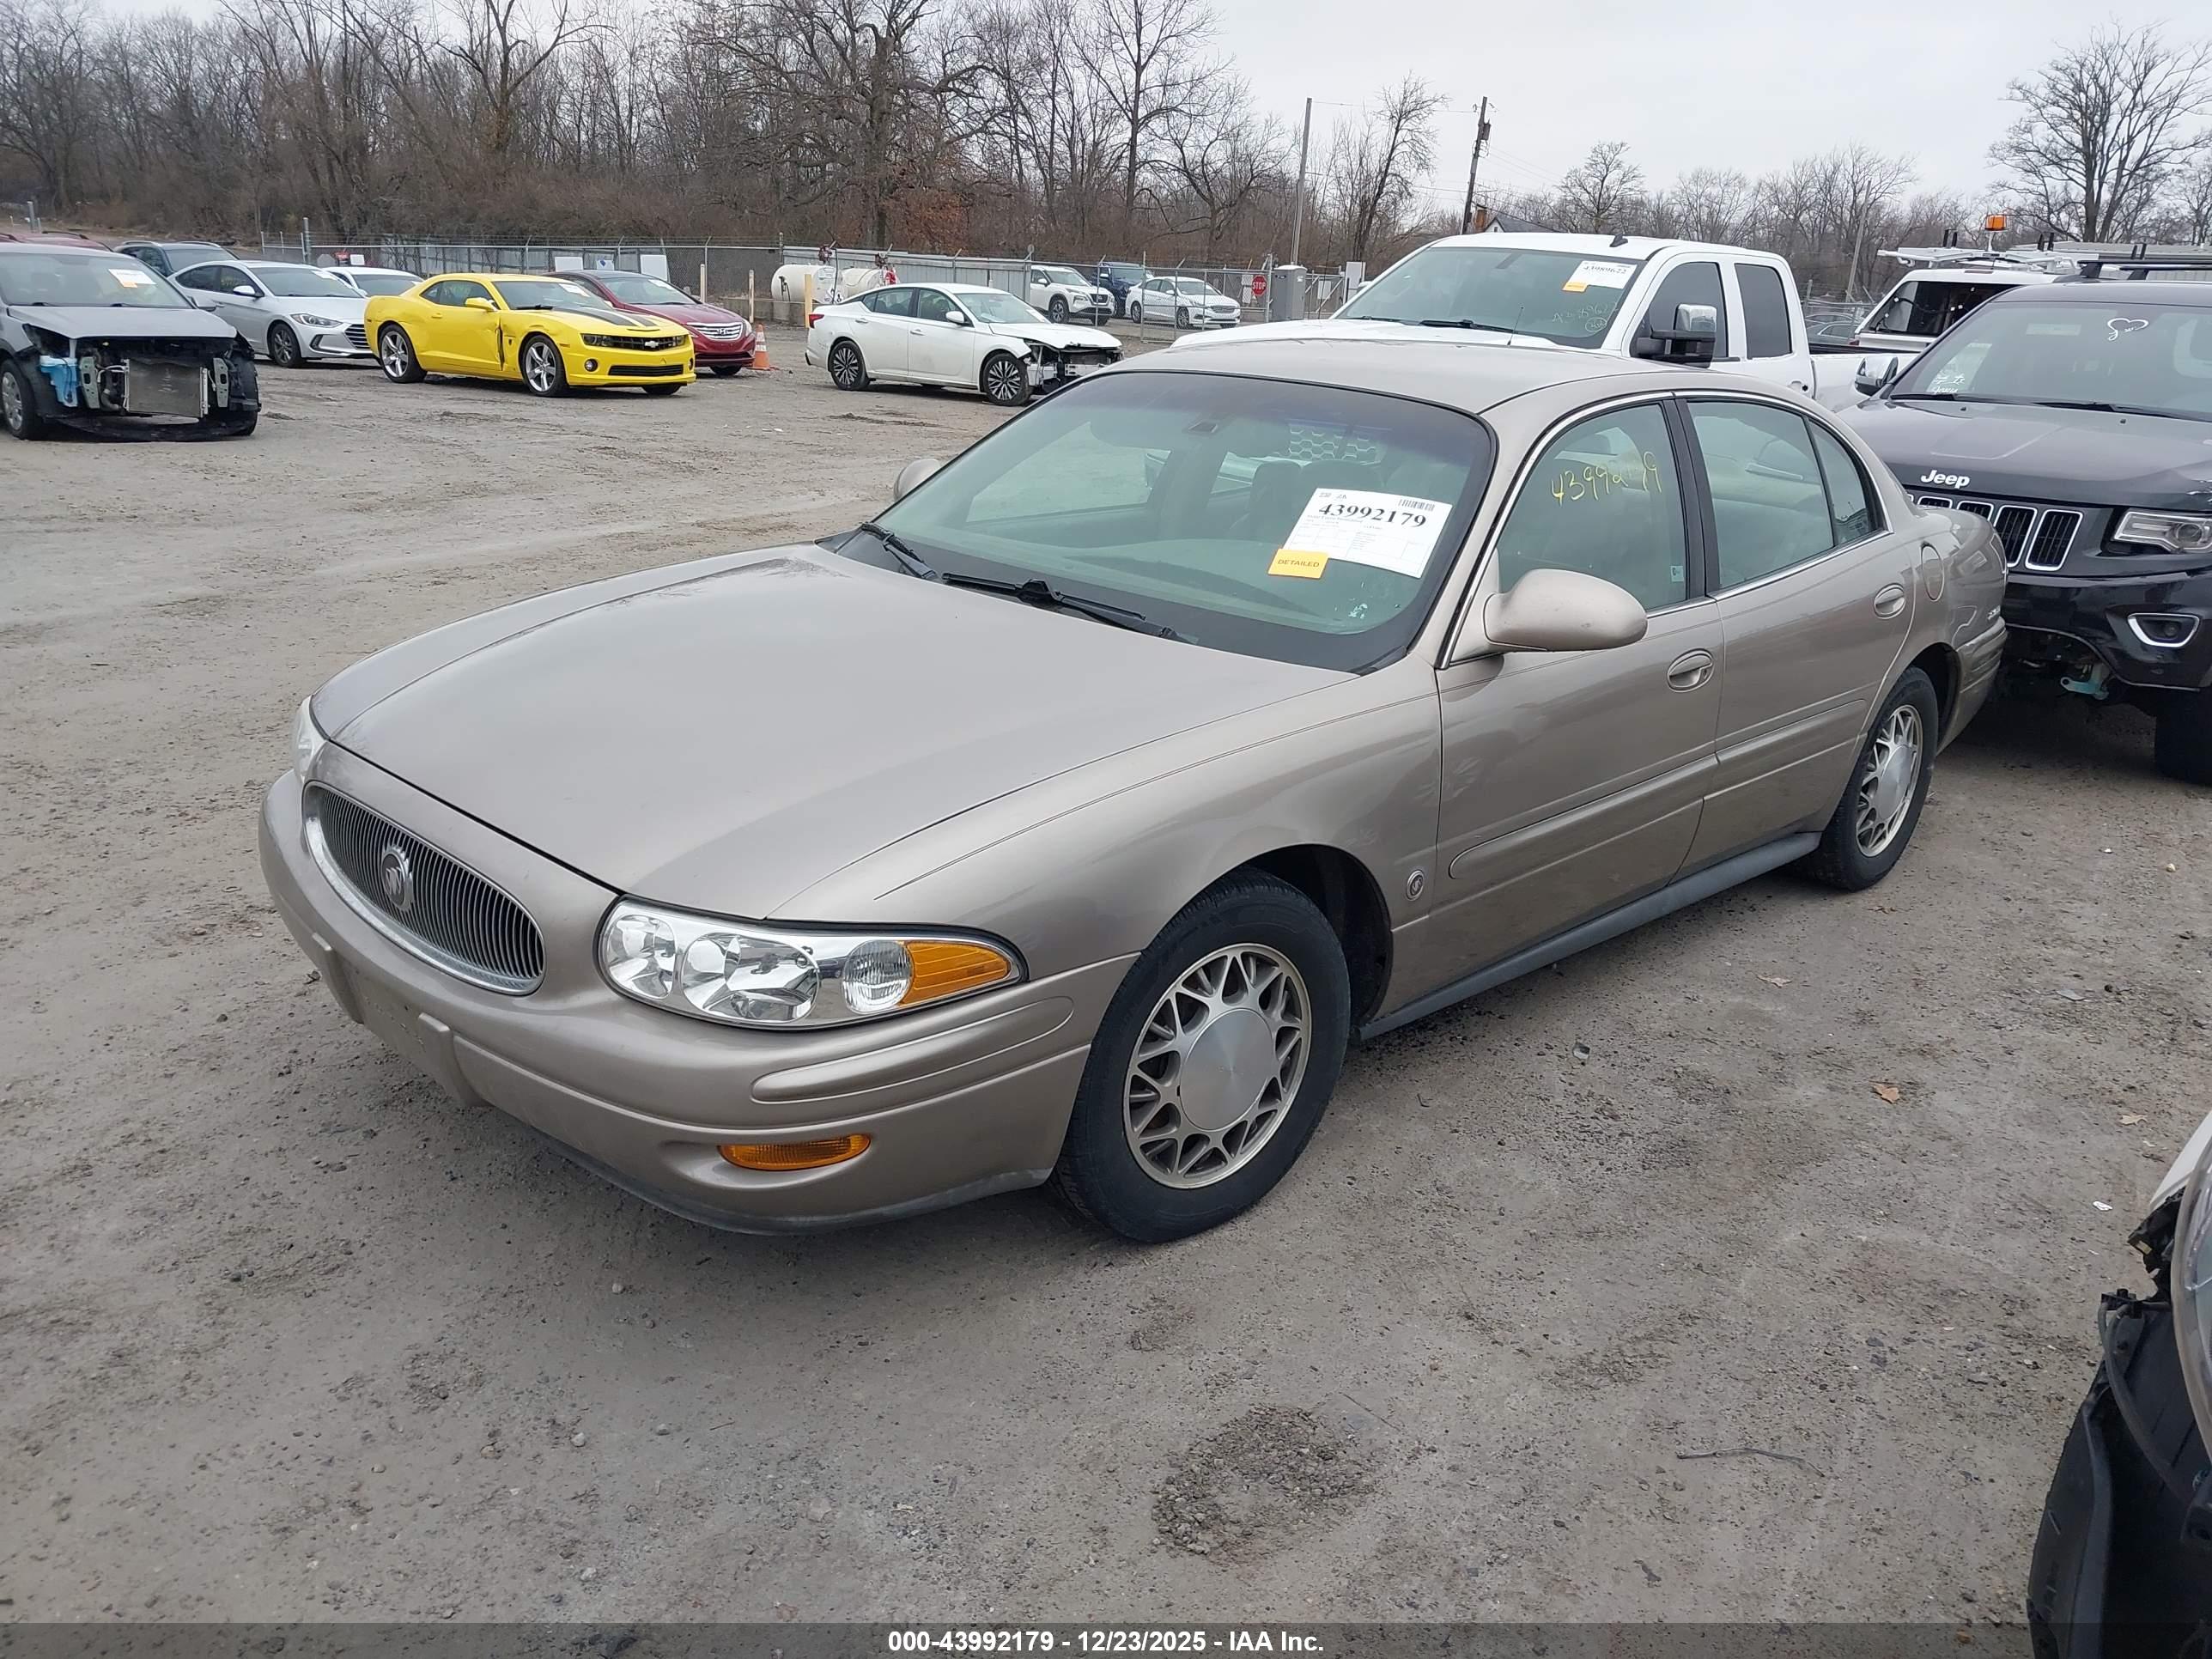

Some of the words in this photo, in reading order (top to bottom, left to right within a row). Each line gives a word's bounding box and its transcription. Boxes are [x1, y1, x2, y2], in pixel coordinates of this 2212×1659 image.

[1252, 281, 1267, 290] STOP
[1920, 469, 1971, 489] Jeep
[1318, 503, 1427, 528] 43992179
[1277, 558, 1321, 568] DETAILED
